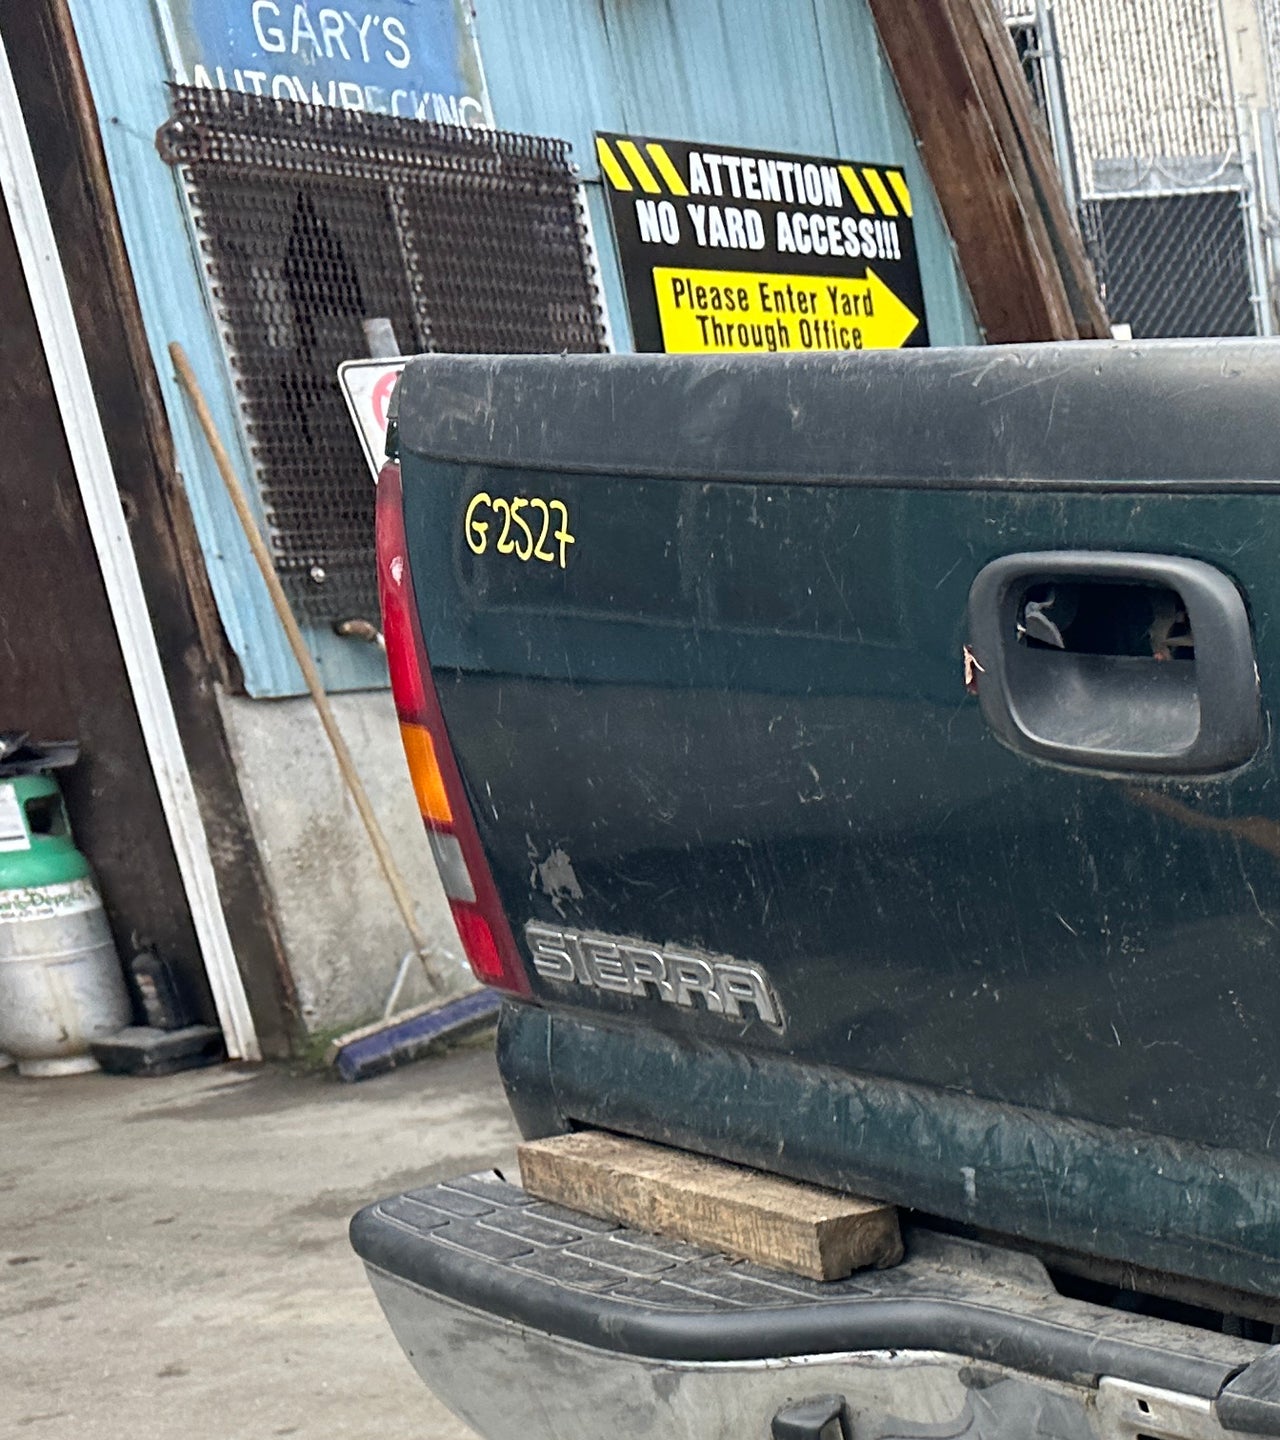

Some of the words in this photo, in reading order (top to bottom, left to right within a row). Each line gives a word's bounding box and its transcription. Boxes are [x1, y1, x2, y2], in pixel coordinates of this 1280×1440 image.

[252, 1, 411, 69] GARY'S
[689, 152, 843, 208] ATTENTION
[636, 200, 680, 245] NO
[687, 204, 765, 251] YARD
[777, 211, 901, 260] ACCESS!!!
[672, 278, 750, 312] Please
[759, 282, 817, 314] Enter
[827, 286, 875, 317] Yard
[696, 315, 789, 351] Through
[800, 319, 863, 350] Office
[465, 492, 576, 569] G2527
[525, 923, 784, 1032] SIERRA
